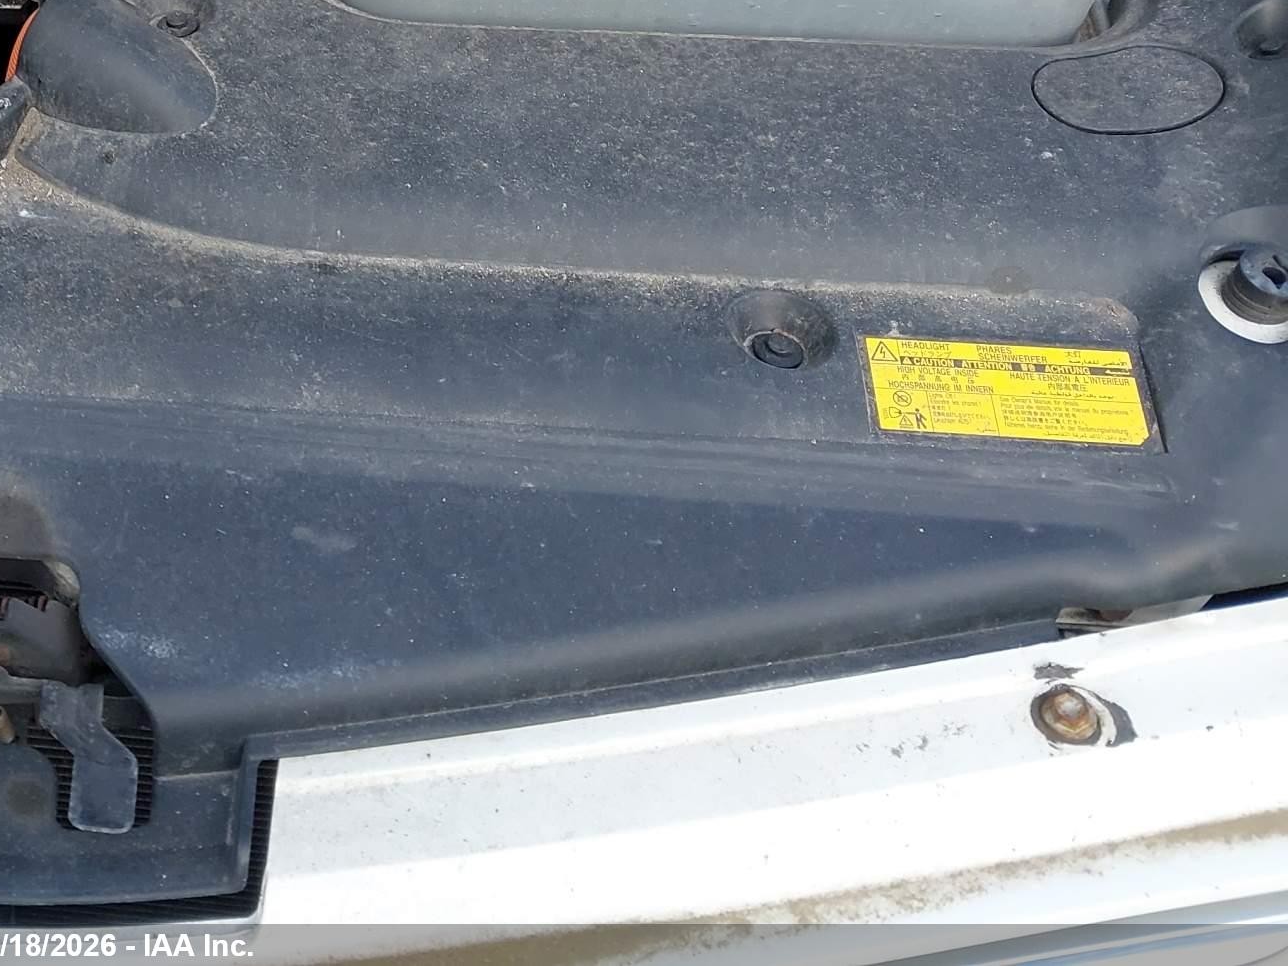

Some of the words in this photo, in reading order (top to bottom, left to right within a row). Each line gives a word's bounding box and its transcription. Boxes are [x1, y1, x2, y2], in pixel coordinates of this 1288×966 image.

[901, 341, 950, 351] HEADLIGHT
[976, 345, 1012, 354] PHARES
[978, 353, 1047, 363] SCHEINWERFER
[897, 365, 915, 374] HIGH
[918, 367, 951, 375] VOLTAGE
[954, 369, 980, 377] INSIDE
[913, 357, 955, 367] CAUTION
[961, 359, 1012, 371] ATTENTION
[1045, 365, 1091, 375] ACHTUNG
[1010, 372, 1035, 381] HAUTE
[1037, 374, 1072, 383] TENSION
[888, 380, 950, 392] HOCHSPANNUNG
[954, 383, 962, 392] IM
[965, 384, 994, 394] INNERN
